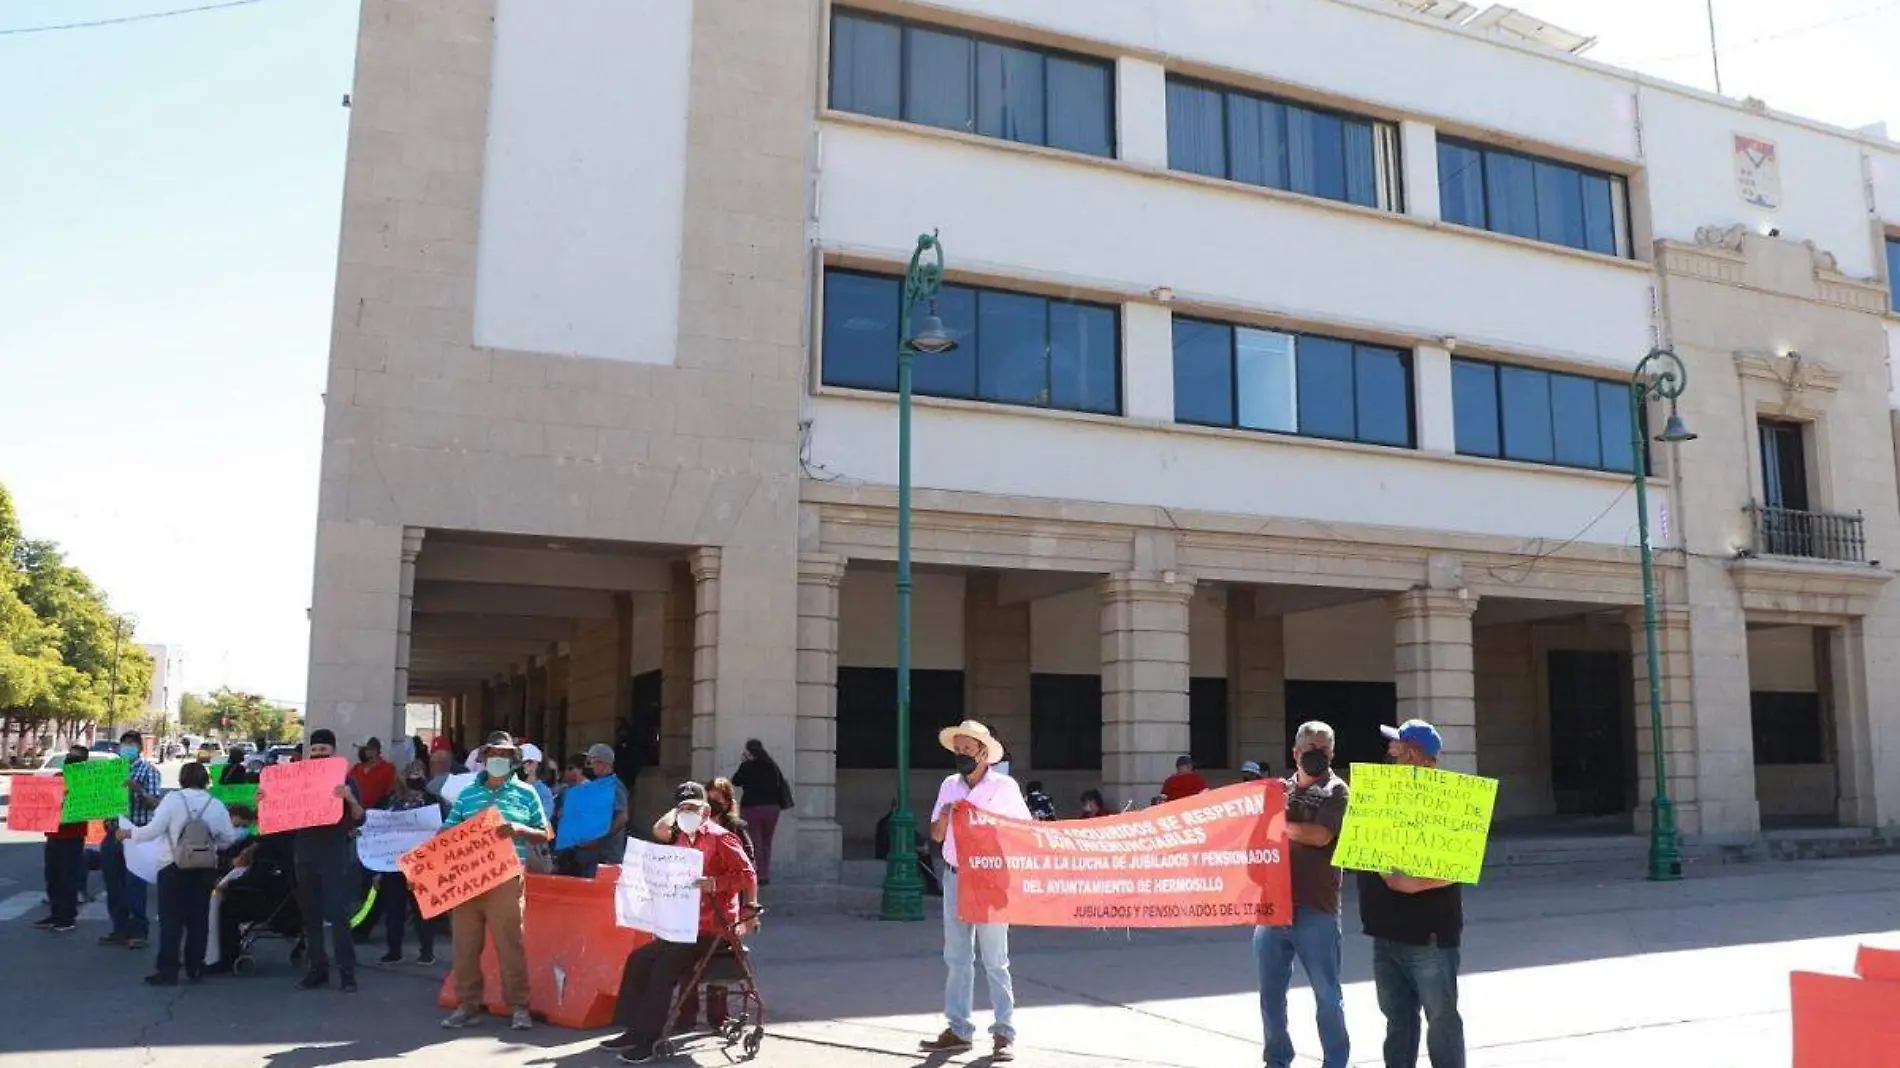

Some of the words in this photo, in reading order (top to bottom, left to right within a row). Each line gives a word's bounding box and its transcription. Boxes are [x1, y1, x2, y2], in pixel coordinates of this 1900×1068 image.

[1157, 814, 1182, 832] SE
[1181, 793, 1265, 827] RESPETAN
[1464, 803, 1482, 818] DE
[413, 860, 435, 876] DE
[444, 828, 498, 864] MANDAT
[1005, 854, 1042, 869] TOTAL
[1043, 854, 1053, 869] A
[1055, 854, 1070, 869] LA
[1072, 854, 1110, 869] LUCHA
[1111, 855, 1126, 869] DE
[1128, 852, 1190, 869] JUBILADOS
[1190, 851, 1200, 866] Y
[1200, 849, 1280, 866] PENSIONADOS
[437, 849, 495, 889] ANTONIO
[1022, 879, 1044, 894] DEL
[1046, 878, 1134, 895] AYUNTAMIENTO
[1136, 878, 1152, 894] DE
[1154, 876, 1224, 894] HERMOSILLO
[1073, 903, 1132, 919] JUBILADOS
[1132, 903, 1142, 918] Y
[1142, 902, 1219, 919] PENSIONADOS
[1220, 902, 1241, 916] DEL
